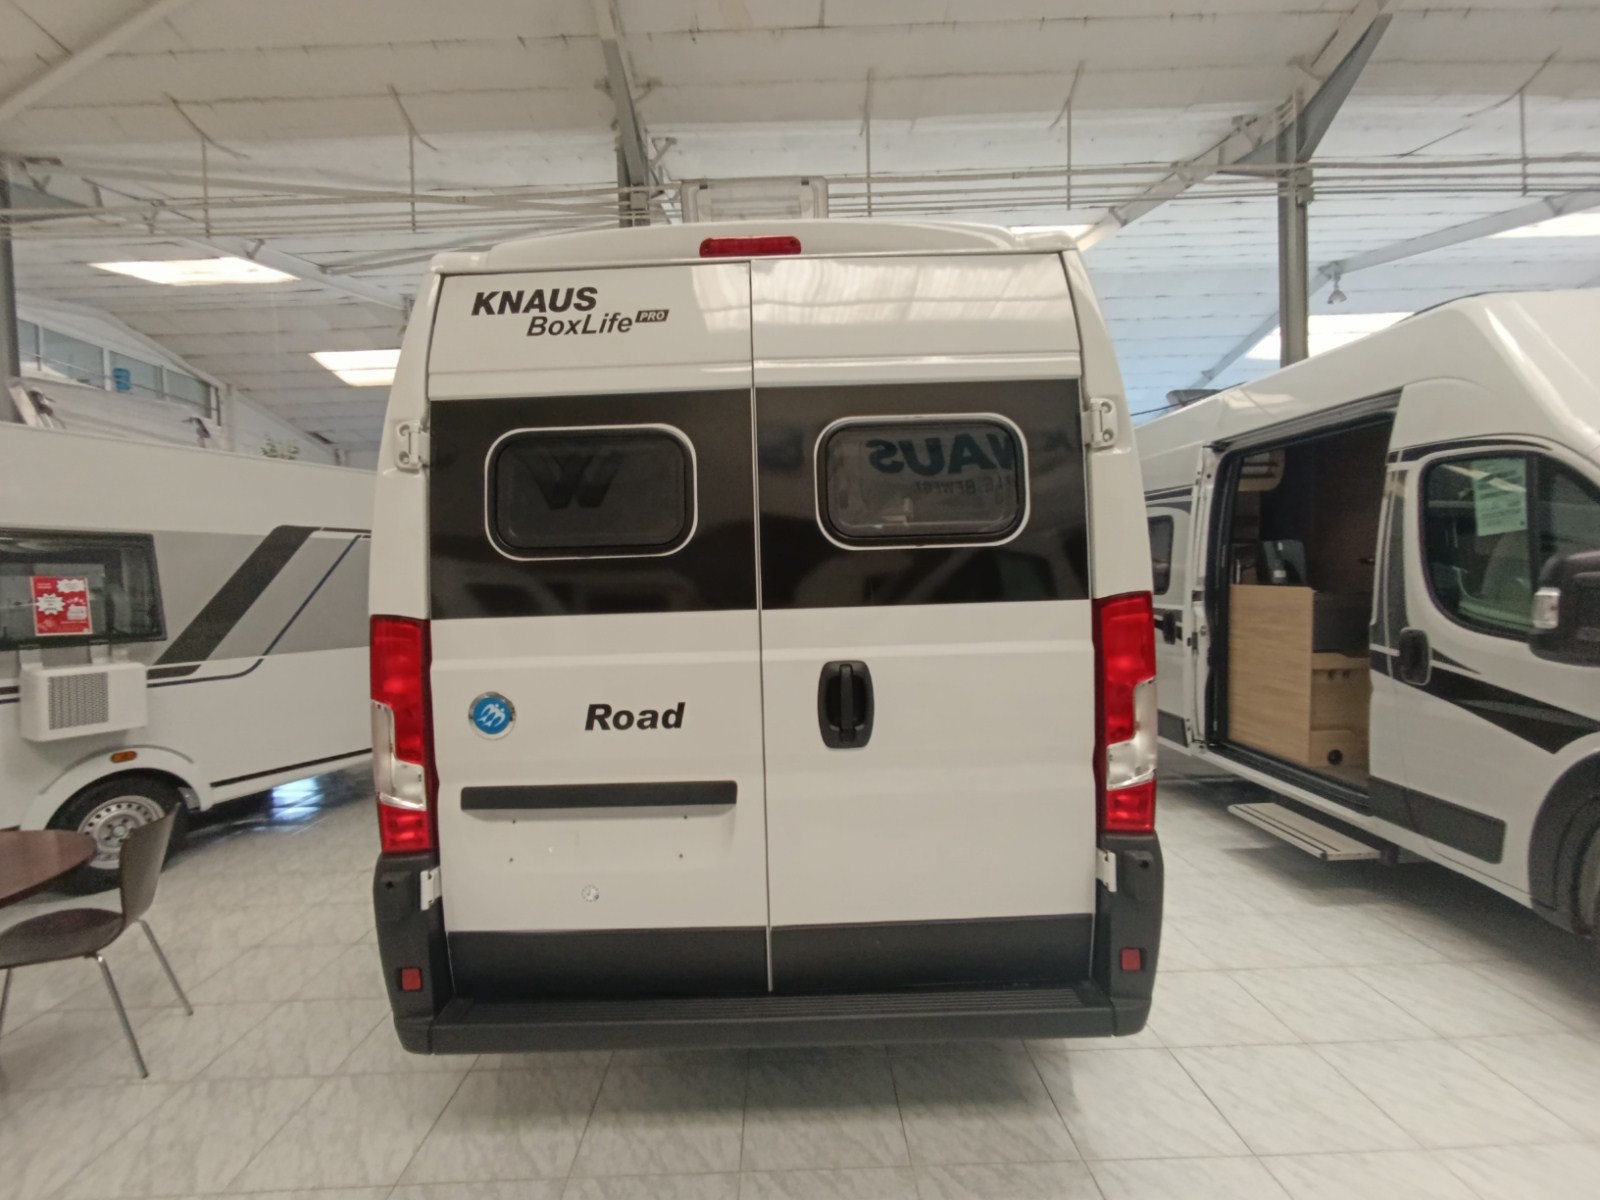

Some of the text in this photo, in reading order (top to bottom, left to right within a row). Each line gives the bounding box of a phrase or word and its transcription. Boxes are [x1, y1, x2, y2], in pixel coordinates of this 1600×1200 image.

[471, 287, 598, 316] KNAUS
[526, 310, 667, 337] BoxLife PRO
[584, 701, 686, 731] Road
